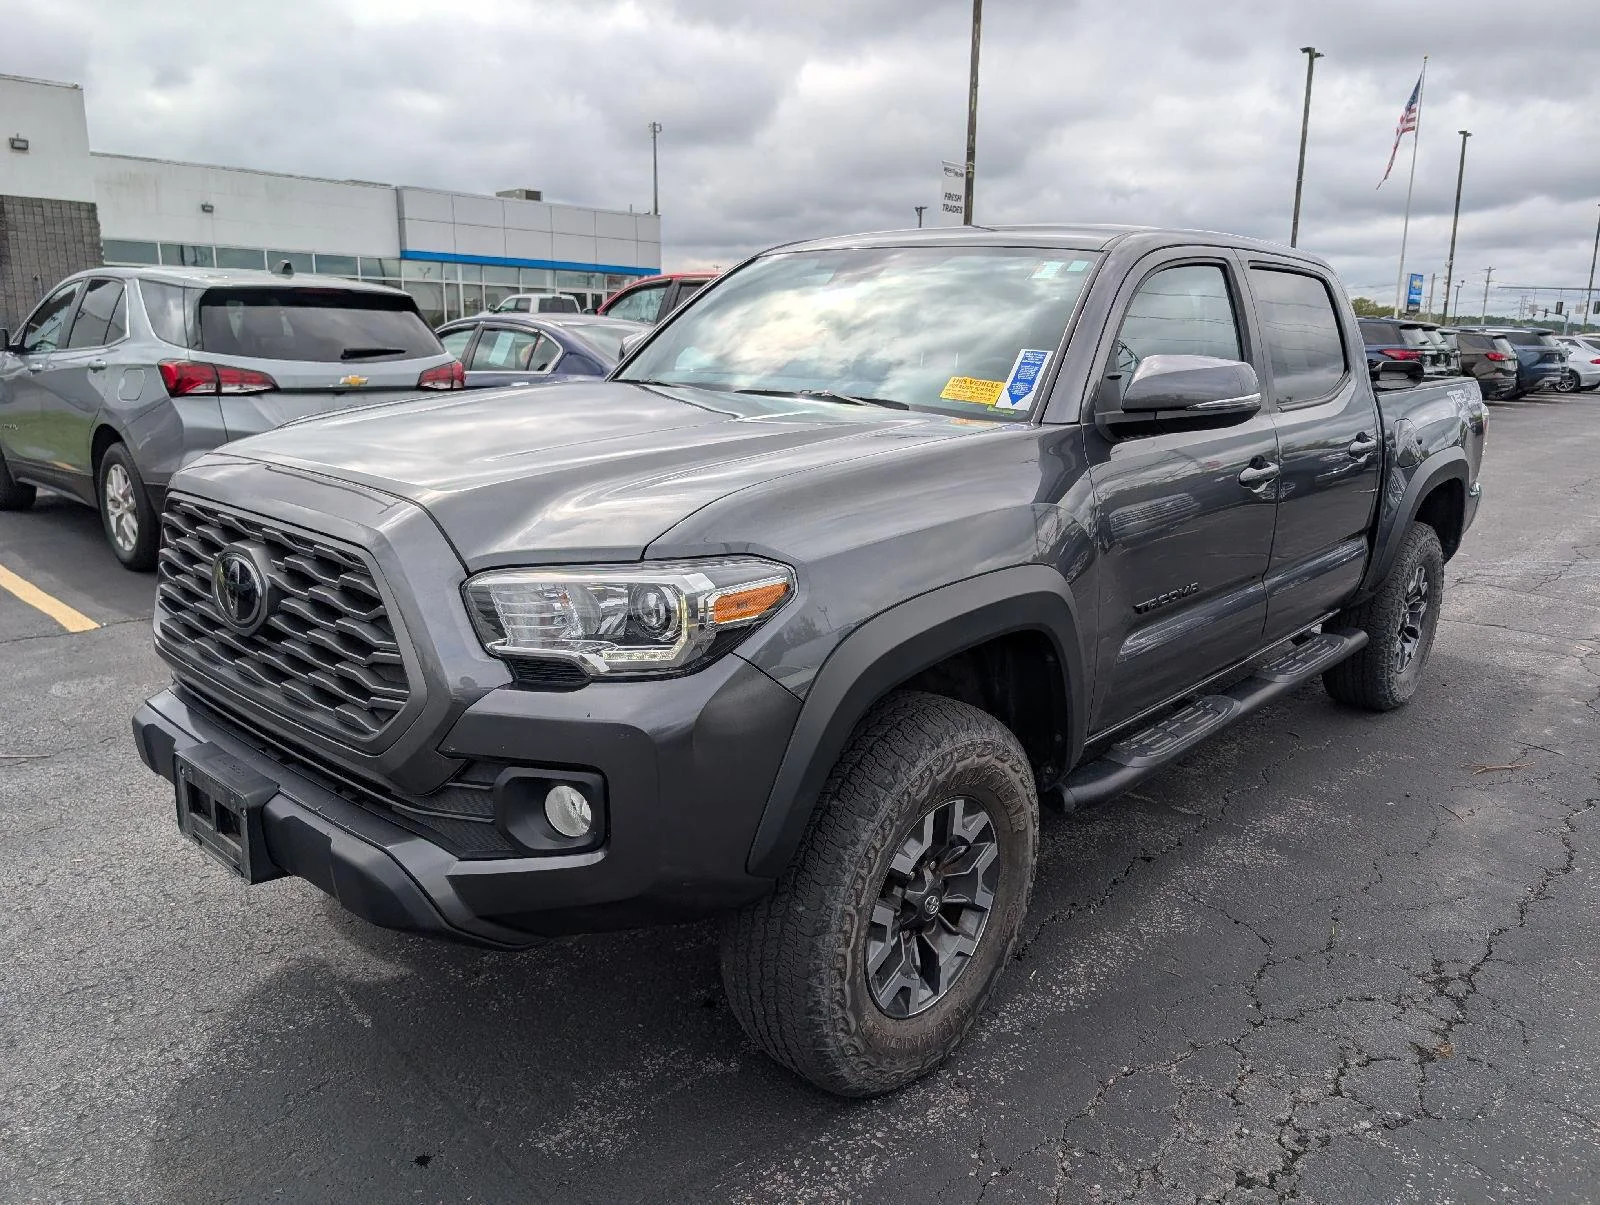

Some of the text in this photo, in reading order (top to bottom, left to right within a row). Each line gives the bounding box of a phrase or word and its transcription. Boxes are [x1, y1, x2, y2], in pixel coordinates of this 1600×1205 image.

[944, 192, 962, 202] FRESH
[942, 203, 963, 214] TRADES
[969, 379, 1000, 388] VEHICLE
[1132, 582, 1199, 614] TACOMA
